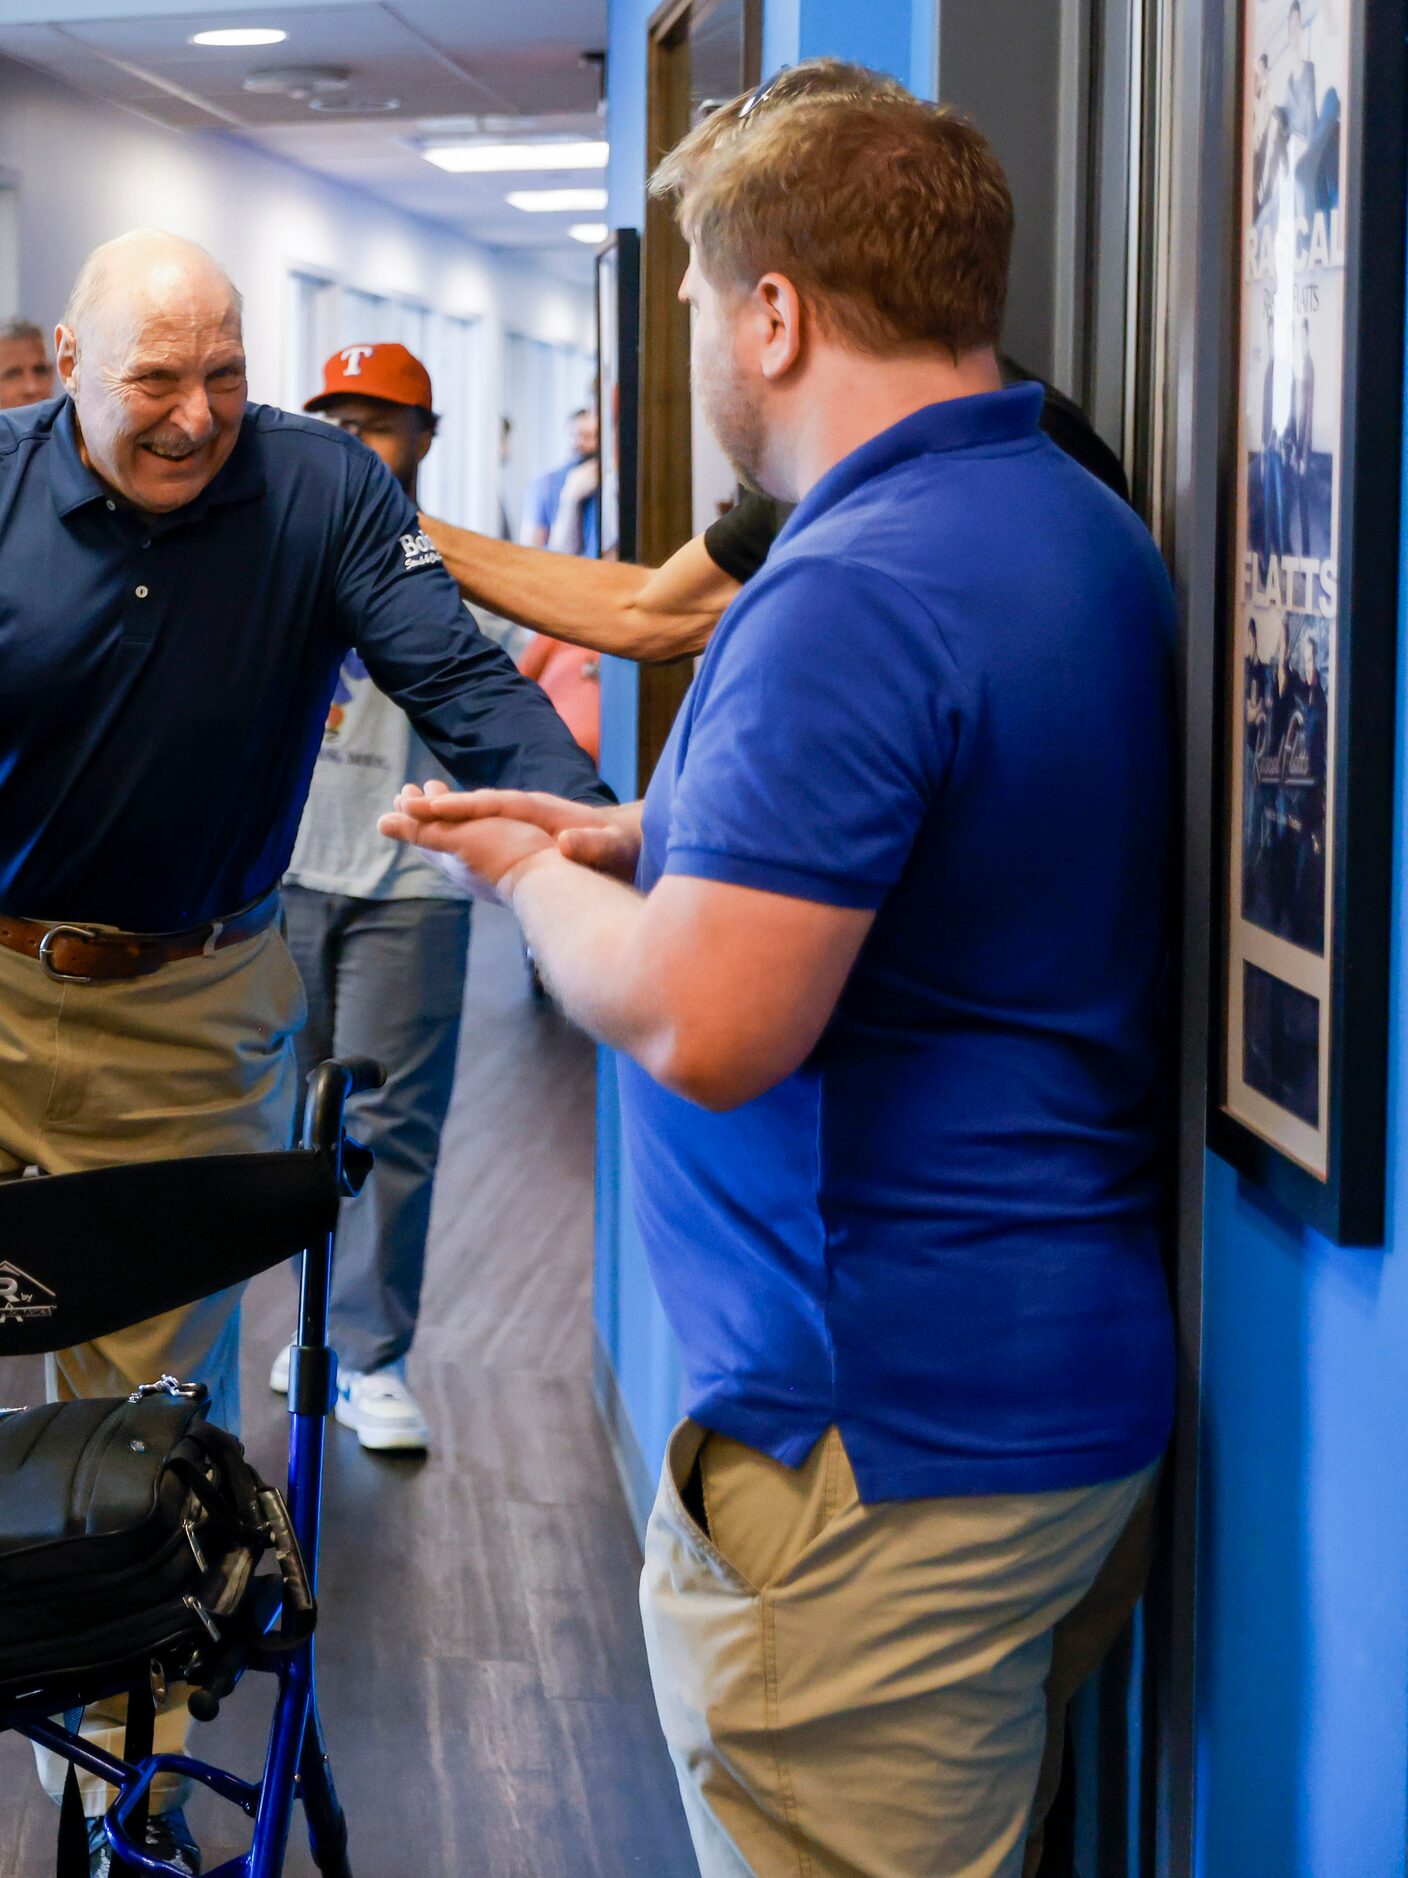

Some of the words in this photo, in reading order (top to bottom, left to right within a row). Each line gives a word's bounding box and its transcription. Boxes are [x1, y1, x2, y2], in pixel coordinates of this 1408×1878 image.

[340, 345, 374, 377] T
[1240, 551, 1338, 618] FLATTS
[21, 1292, 33, 1302] by
